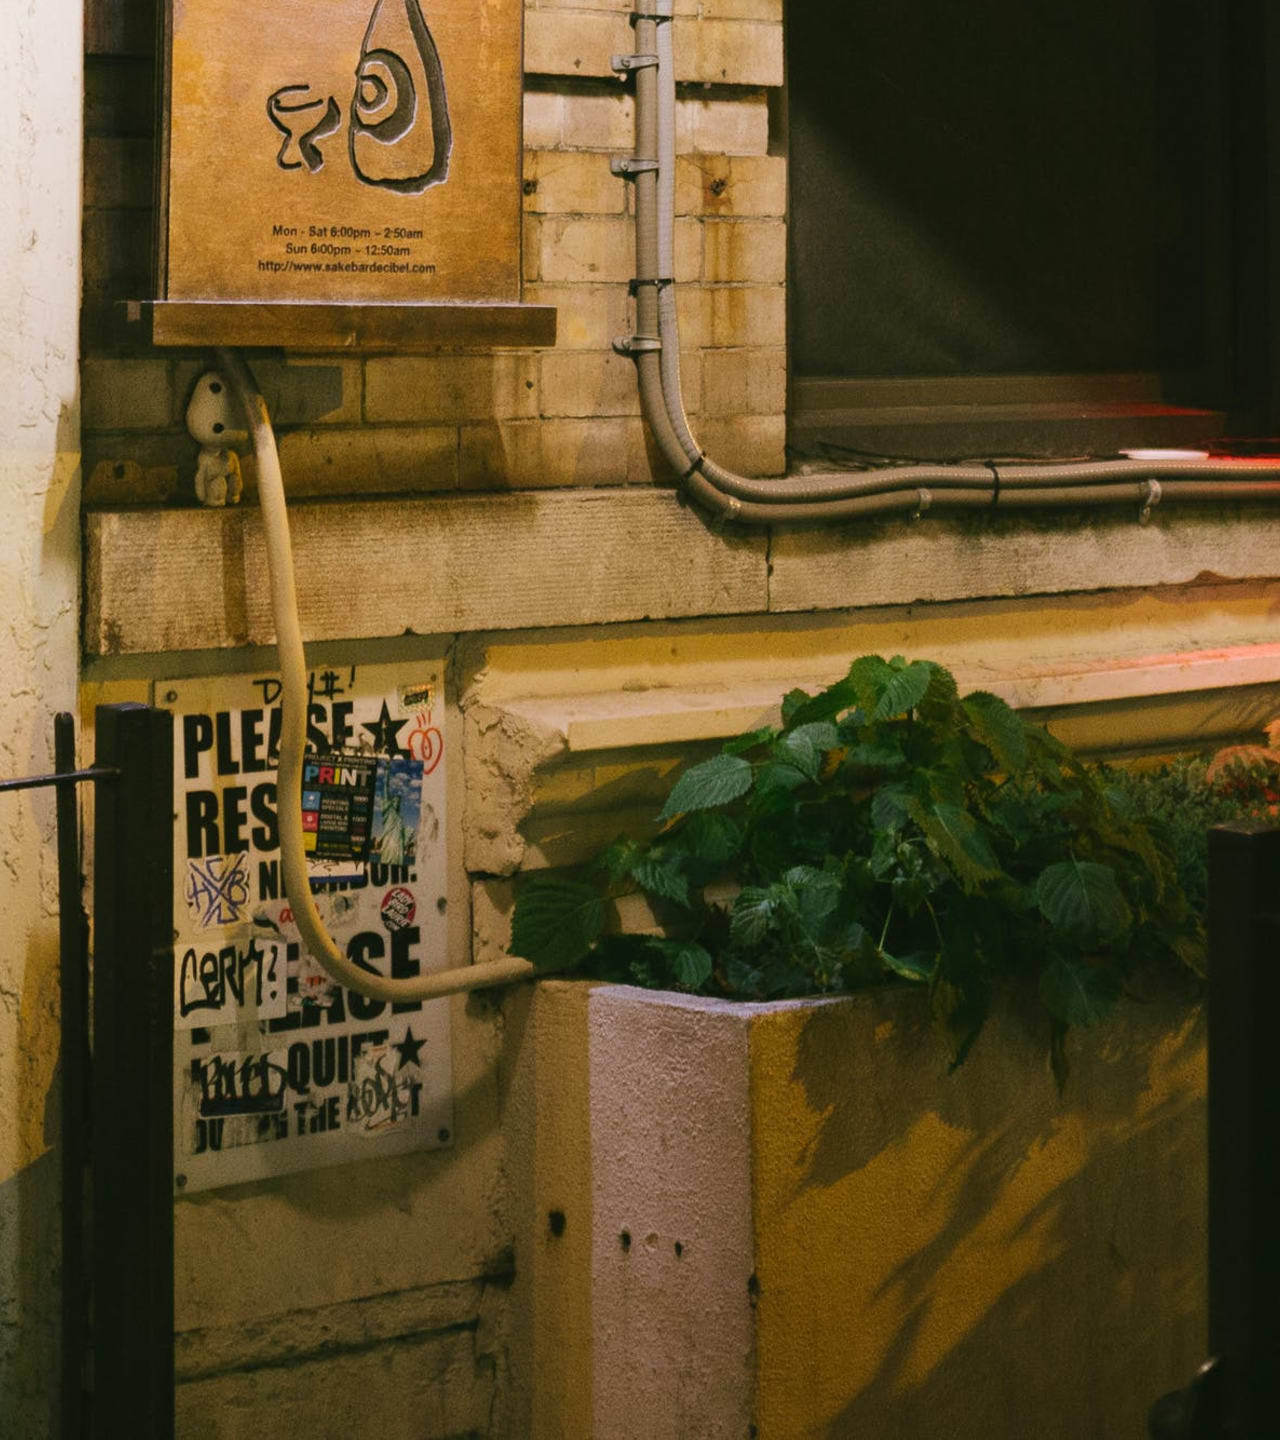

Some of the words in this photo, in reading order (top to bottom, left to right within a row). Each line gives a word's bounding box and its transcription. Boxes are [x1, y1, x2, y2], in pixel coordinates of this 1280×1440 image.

[272, 225, 297, 237] Mon
[309, 226, 327, 237] Sat
[330, 226, 370, 240] 6:00pm
[384, 227, 423, 239] 2:50am
[286, 243, 307, 254] Sun
[311, 243, 351, 257] 6:00pm
[365, 245, 410, 257] 12:50am
[258, 260, 436, 274] http://www.sakebardecibel.com
[304, 765, 372, 788] PRINT
